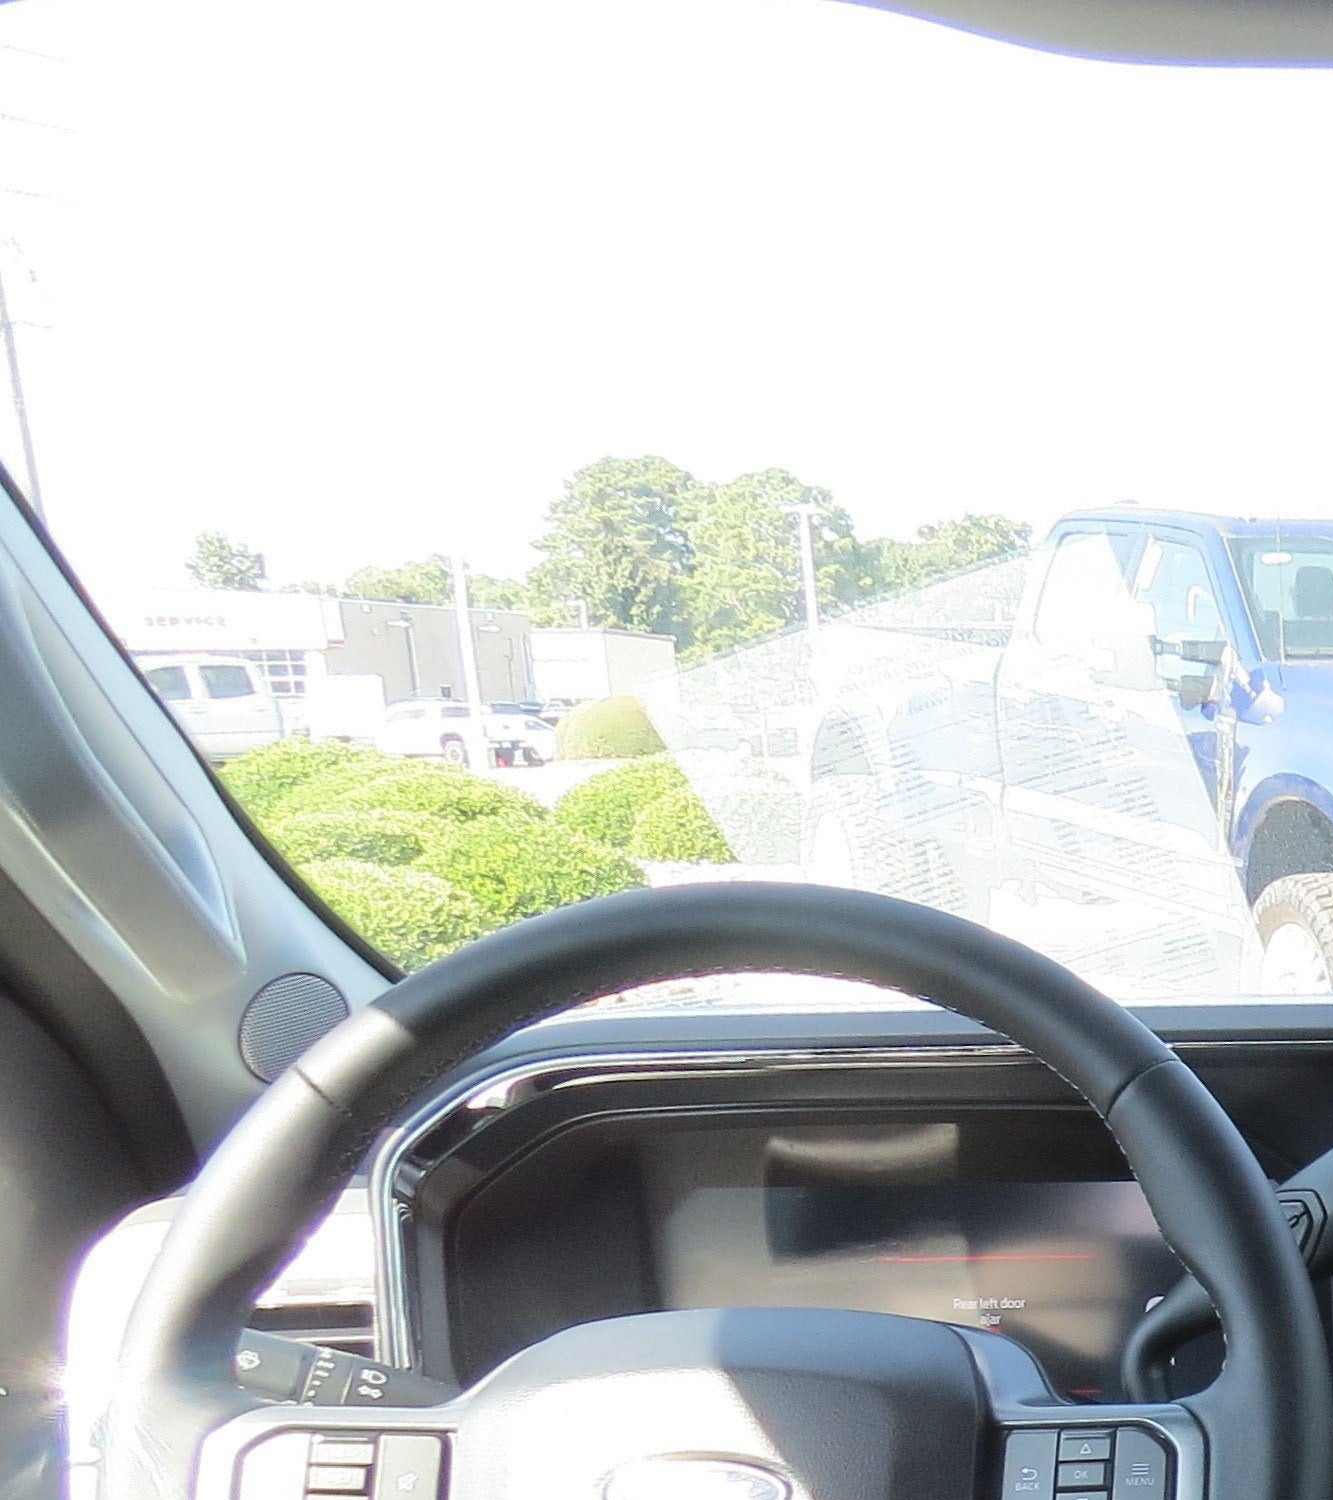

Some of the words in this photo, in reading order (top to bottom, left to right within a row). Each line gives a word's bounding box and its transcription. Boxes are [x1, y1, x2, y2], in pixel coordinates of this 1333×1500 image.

[953, 1298, 978, 1309] Rear
[979, 1298, 999, 1309] left
[1000, 1298, 1026, 1308] door
[980, 1313, 1002, 1326] ajar
[1074, 1470, 1089, 1480] OK
[1014, 1481, 1041, 1492] BACK
[1124, 1477, 1155, 1487] MENU
